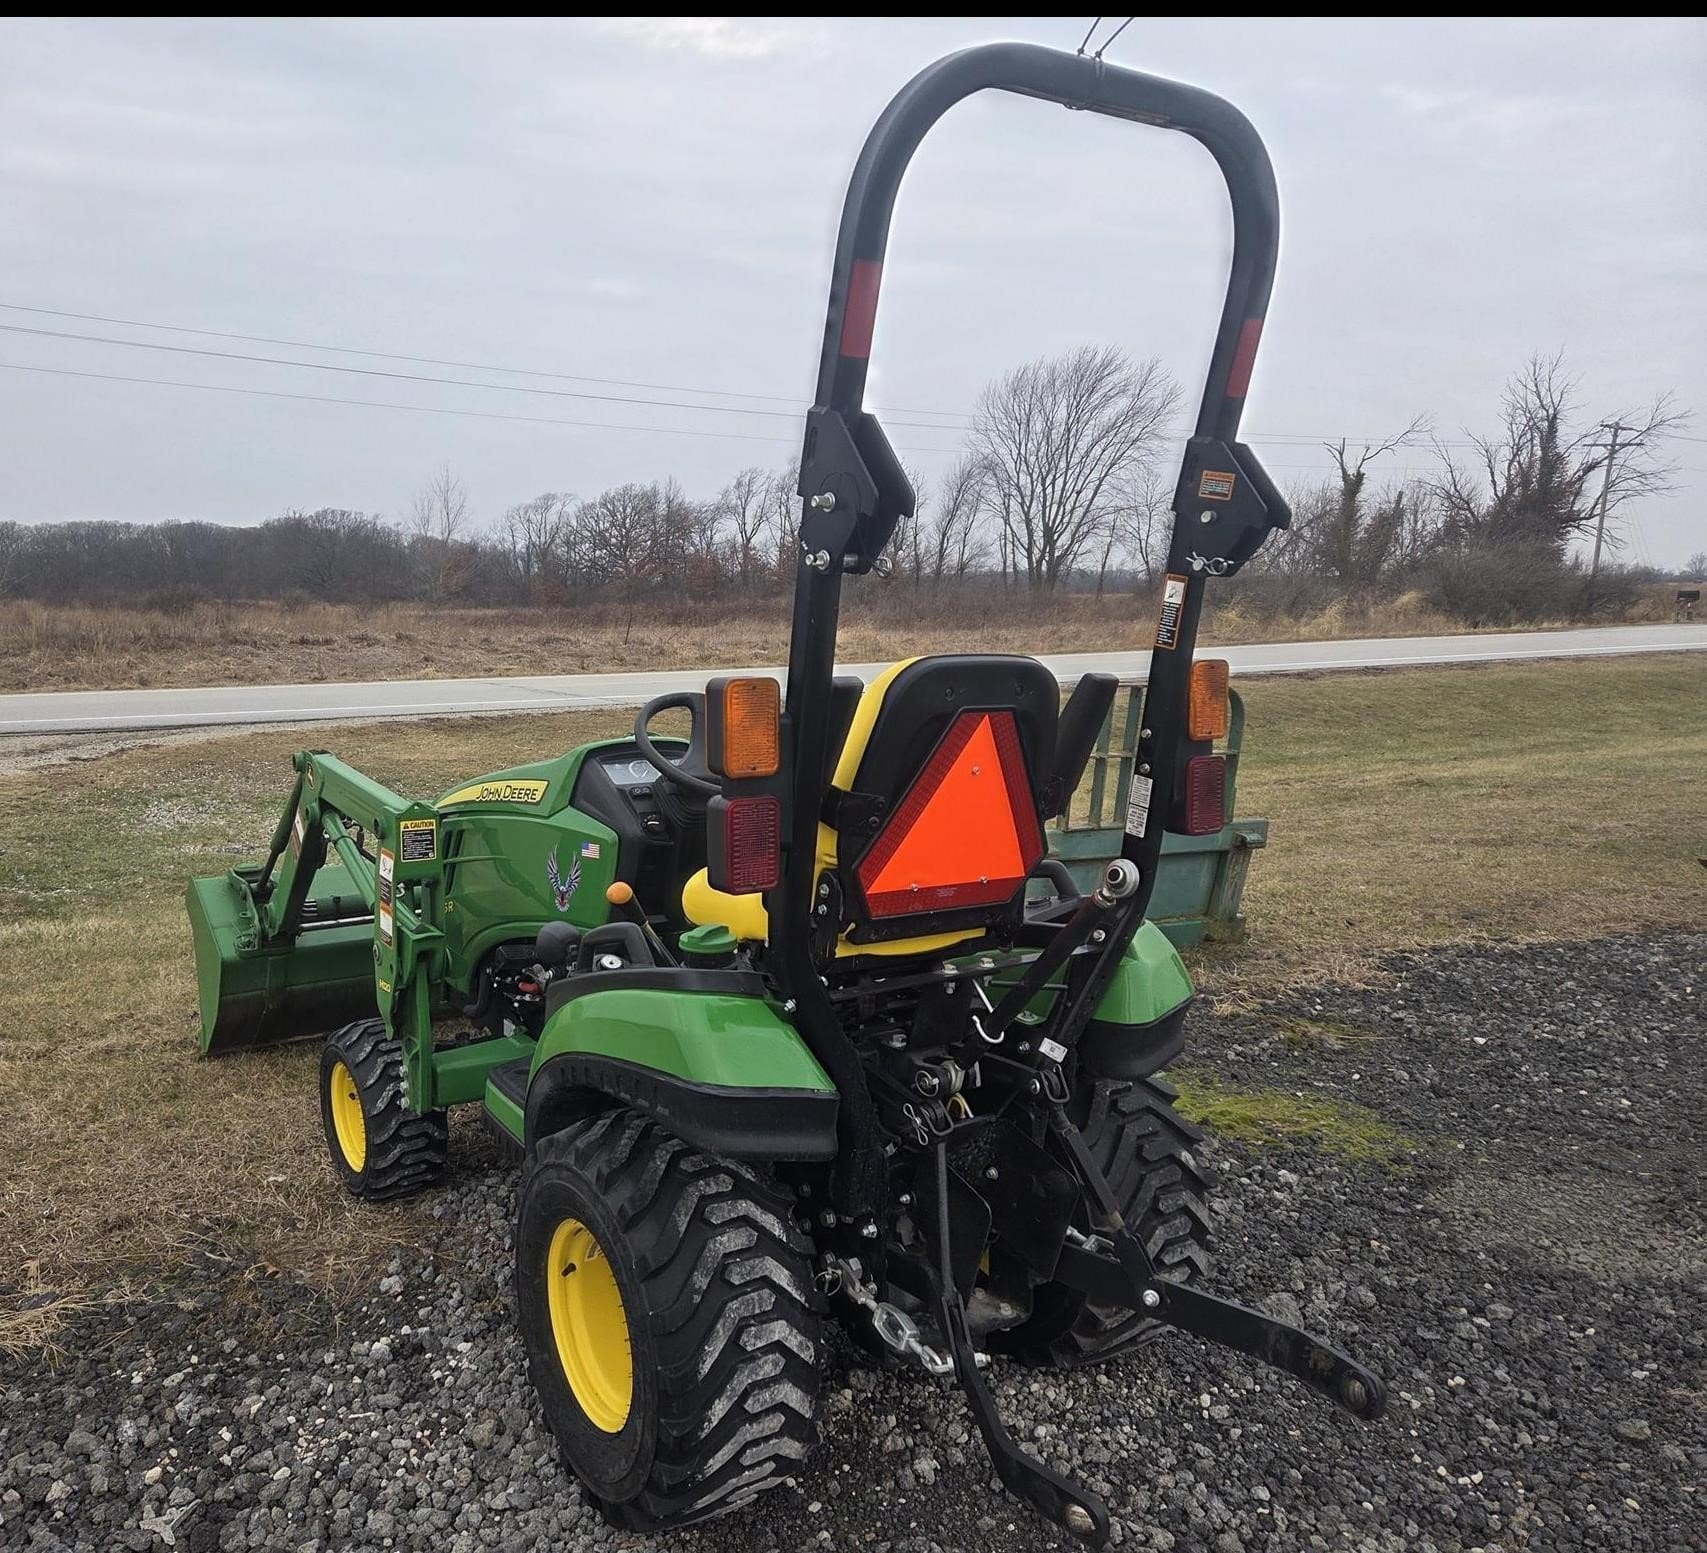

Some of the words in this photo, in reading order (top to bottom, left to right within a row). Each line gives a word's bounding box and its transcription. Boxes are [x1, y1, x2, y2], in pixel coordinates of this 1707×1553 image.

[476, 786, 503, 800] JOHN
[503, 785, 538, 801] DEERE
[410, 821, 434, 829] CAUTION
